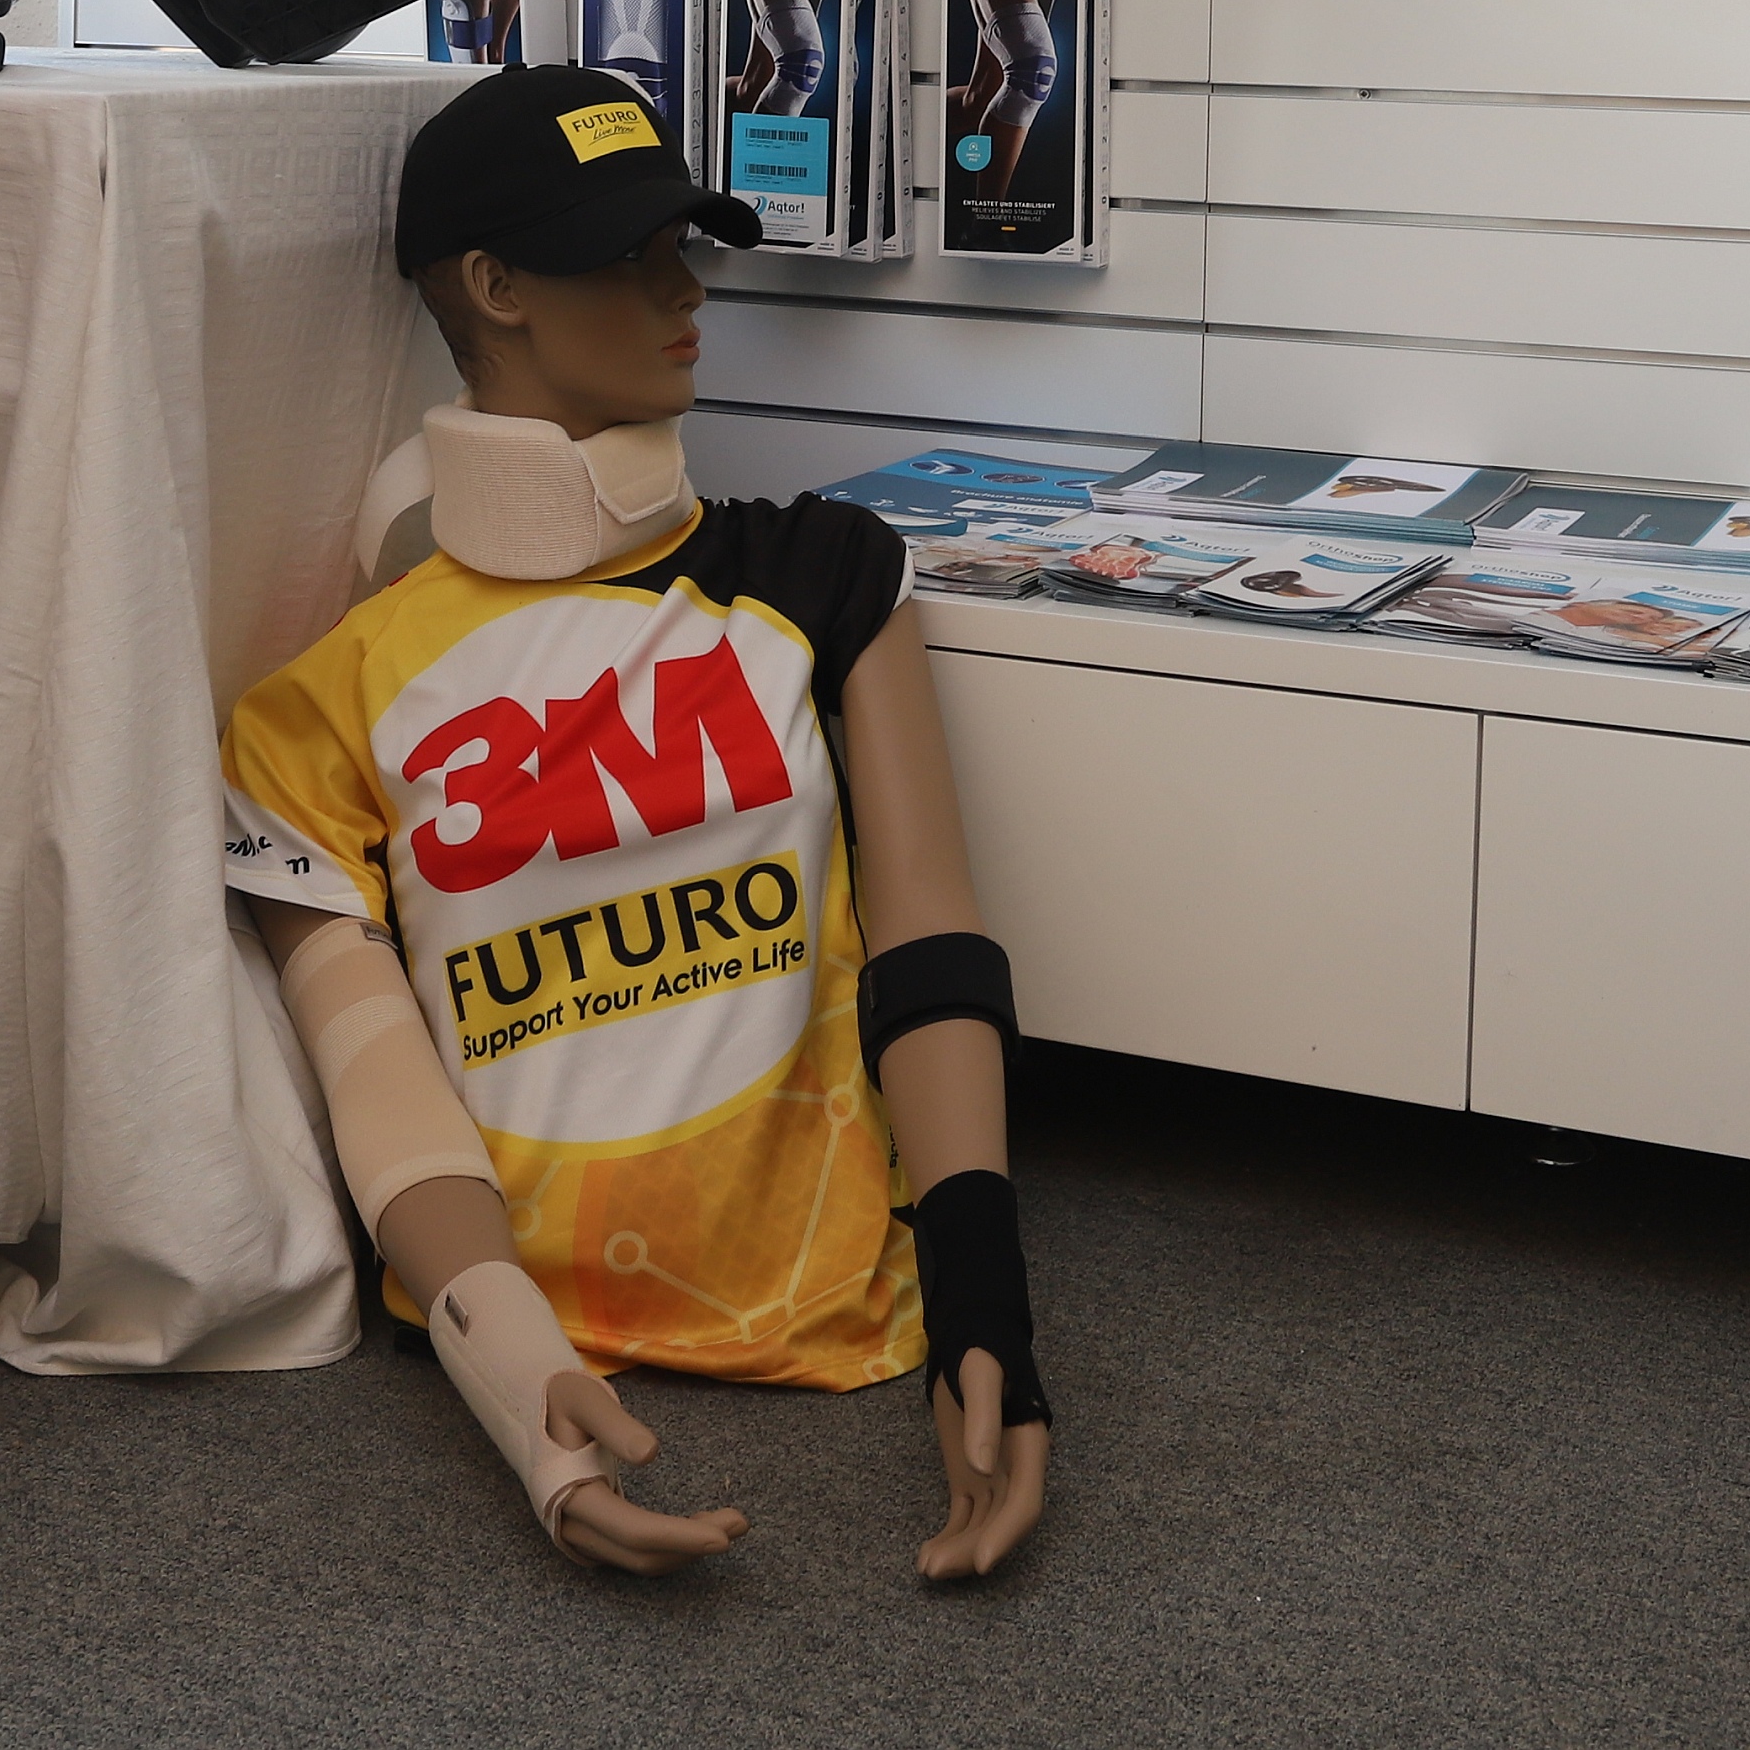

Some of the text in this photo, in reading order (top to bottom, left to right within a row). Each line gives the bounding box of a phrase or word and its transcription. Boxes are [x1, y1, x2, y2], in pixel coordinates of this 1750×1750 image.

[571, 110, 638, 133] FUTURO
[592, 128, 612, 140] Live
[767, 200, 805, 214] Aqtor!
[963, 200, 998, 208] ENTLASTET
[1014, 201, 1056, 209] STABILISIERT
[401, 632, 793, 894] 3M
[445, 861, 798, 1024] FUTURO
[463, 937, 806, 1062] Support Your Active Life
